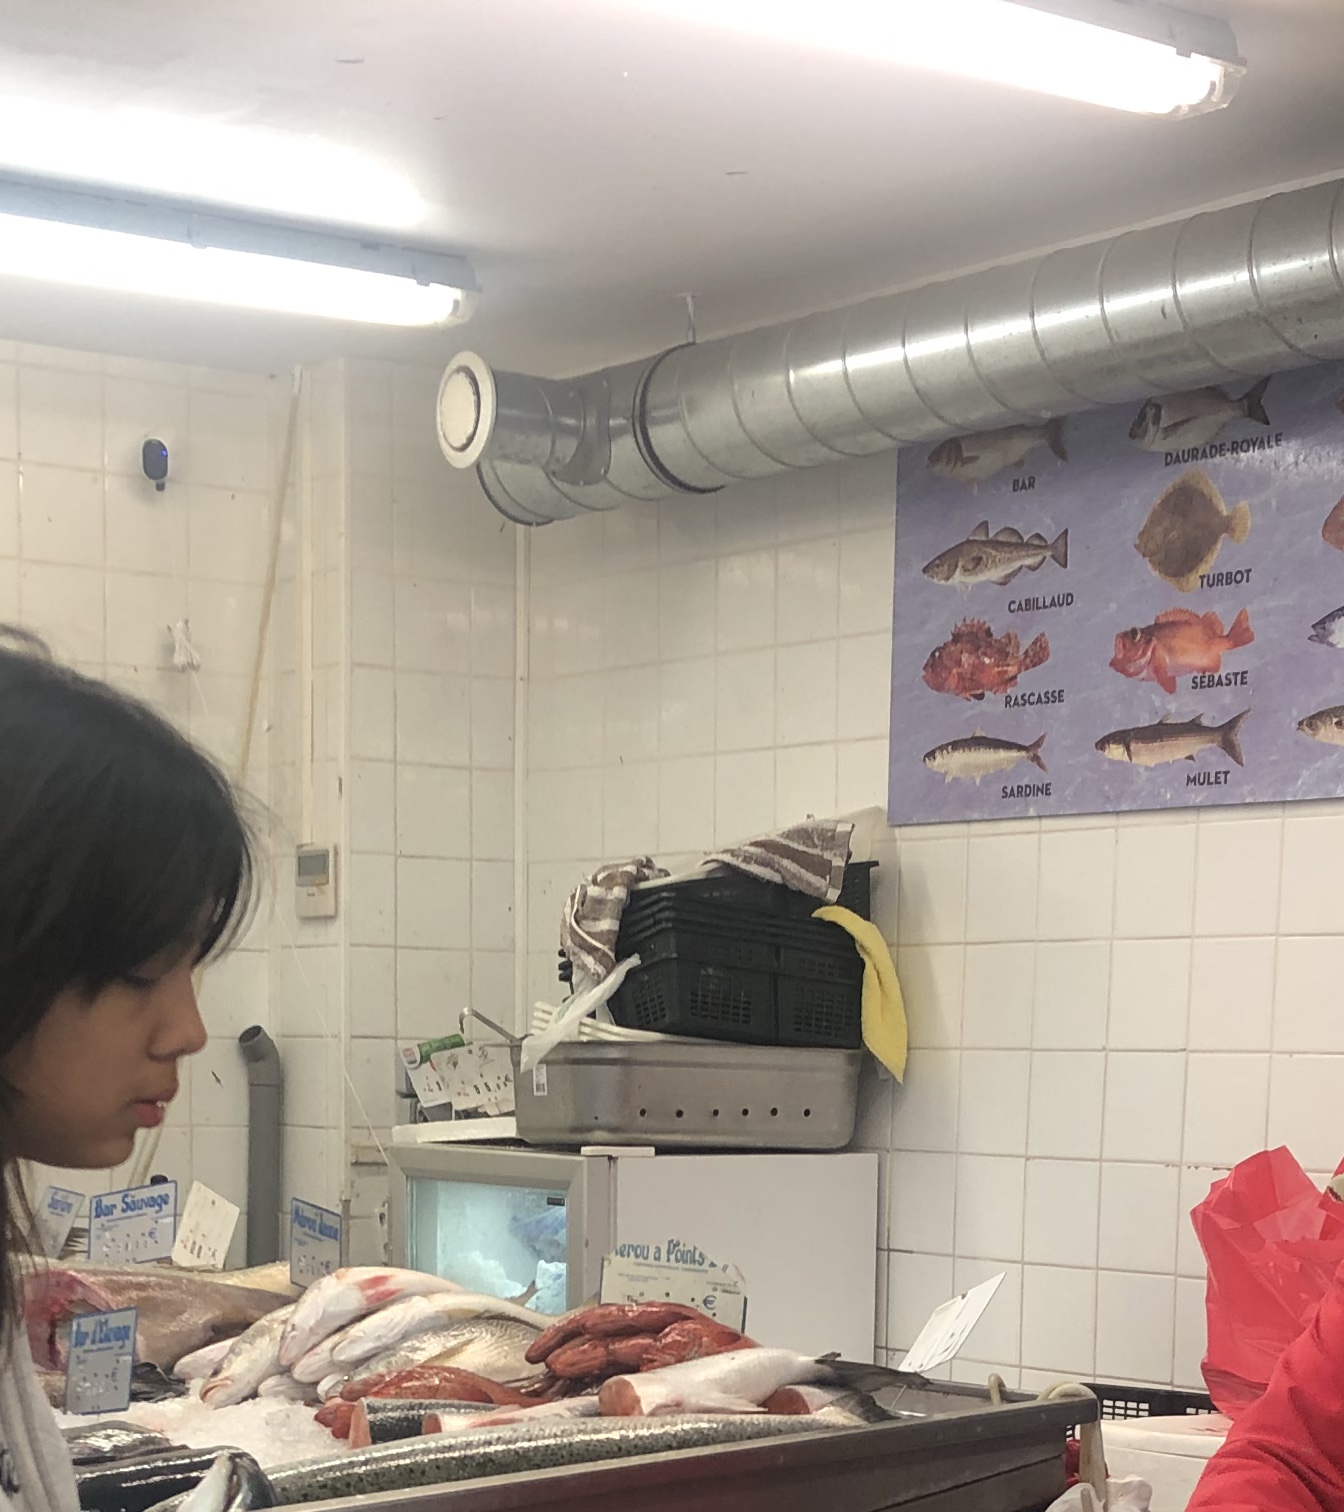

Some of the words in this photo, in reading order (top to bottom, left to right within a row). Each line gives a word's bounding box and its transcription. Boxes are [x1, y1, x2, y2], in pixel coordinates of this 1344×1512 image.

[1164, 432, 1284, 467] DAURADE-ROYALE
[1012, 476, 1036, 493] BAR
[1199, 568, 1253, 589] TURBOT
[1008, 593, 1074, 614] CABILLAUD
[1004, 689, 1065, 709] RASCASSE
[1185, 770, 1231, 787] MULET
[1001, 782, 1052, 799] SARDINE
